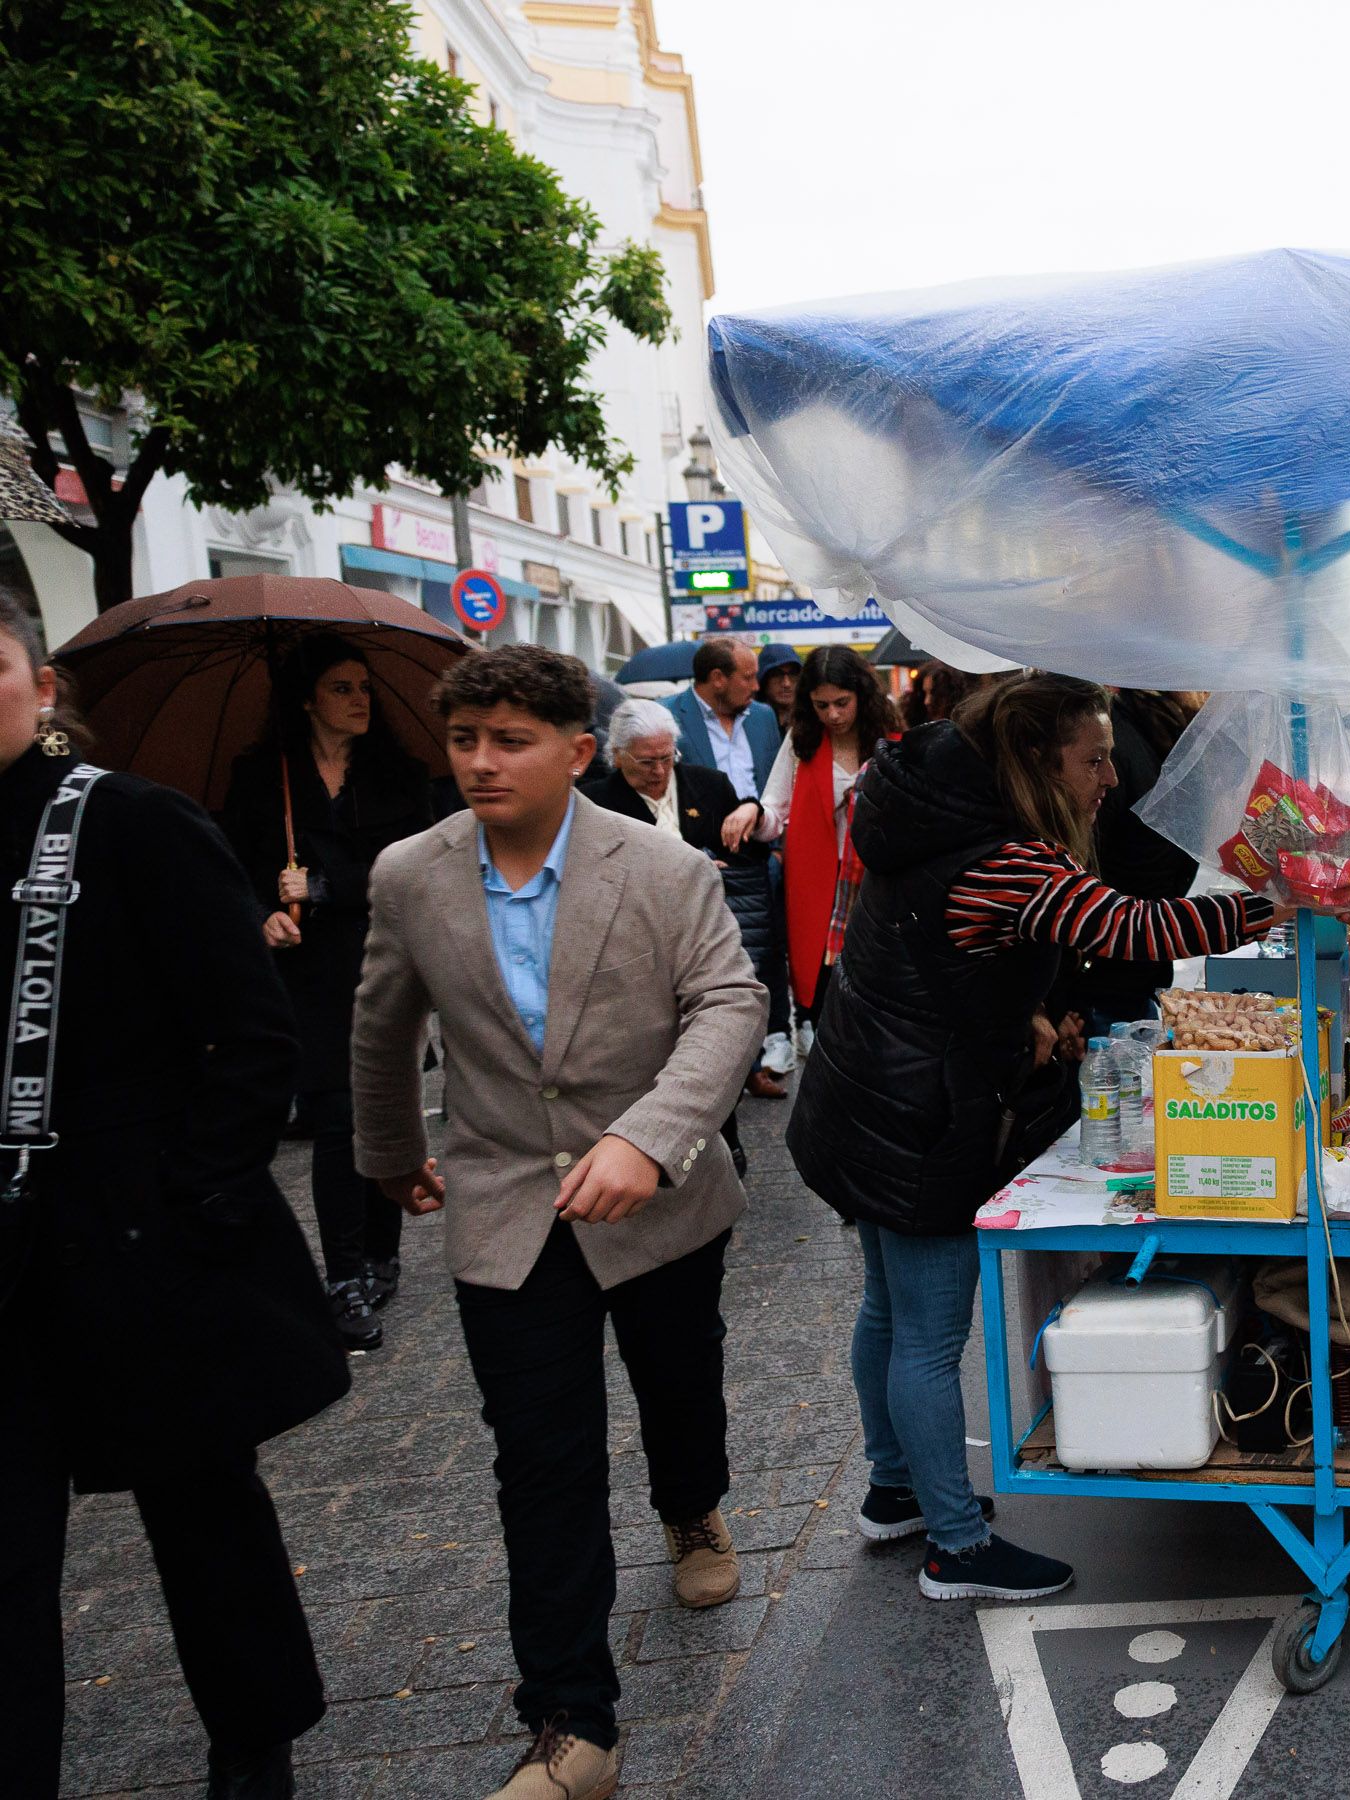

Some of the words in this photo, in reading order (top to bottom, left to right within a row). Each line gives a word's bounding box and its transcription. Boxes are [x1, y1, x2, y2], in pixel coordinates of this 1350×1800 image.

[686, 504, 725, 549] P
[743, 604, 825, 624] Mercado
[1166, 1100, 1277, 1121] SALADITOS
[1198, 1177, 1212, 1186] 11,40
[1212, 1178, 1220, 1187] kg
[1265, 1179, 1273, 1188] kg
